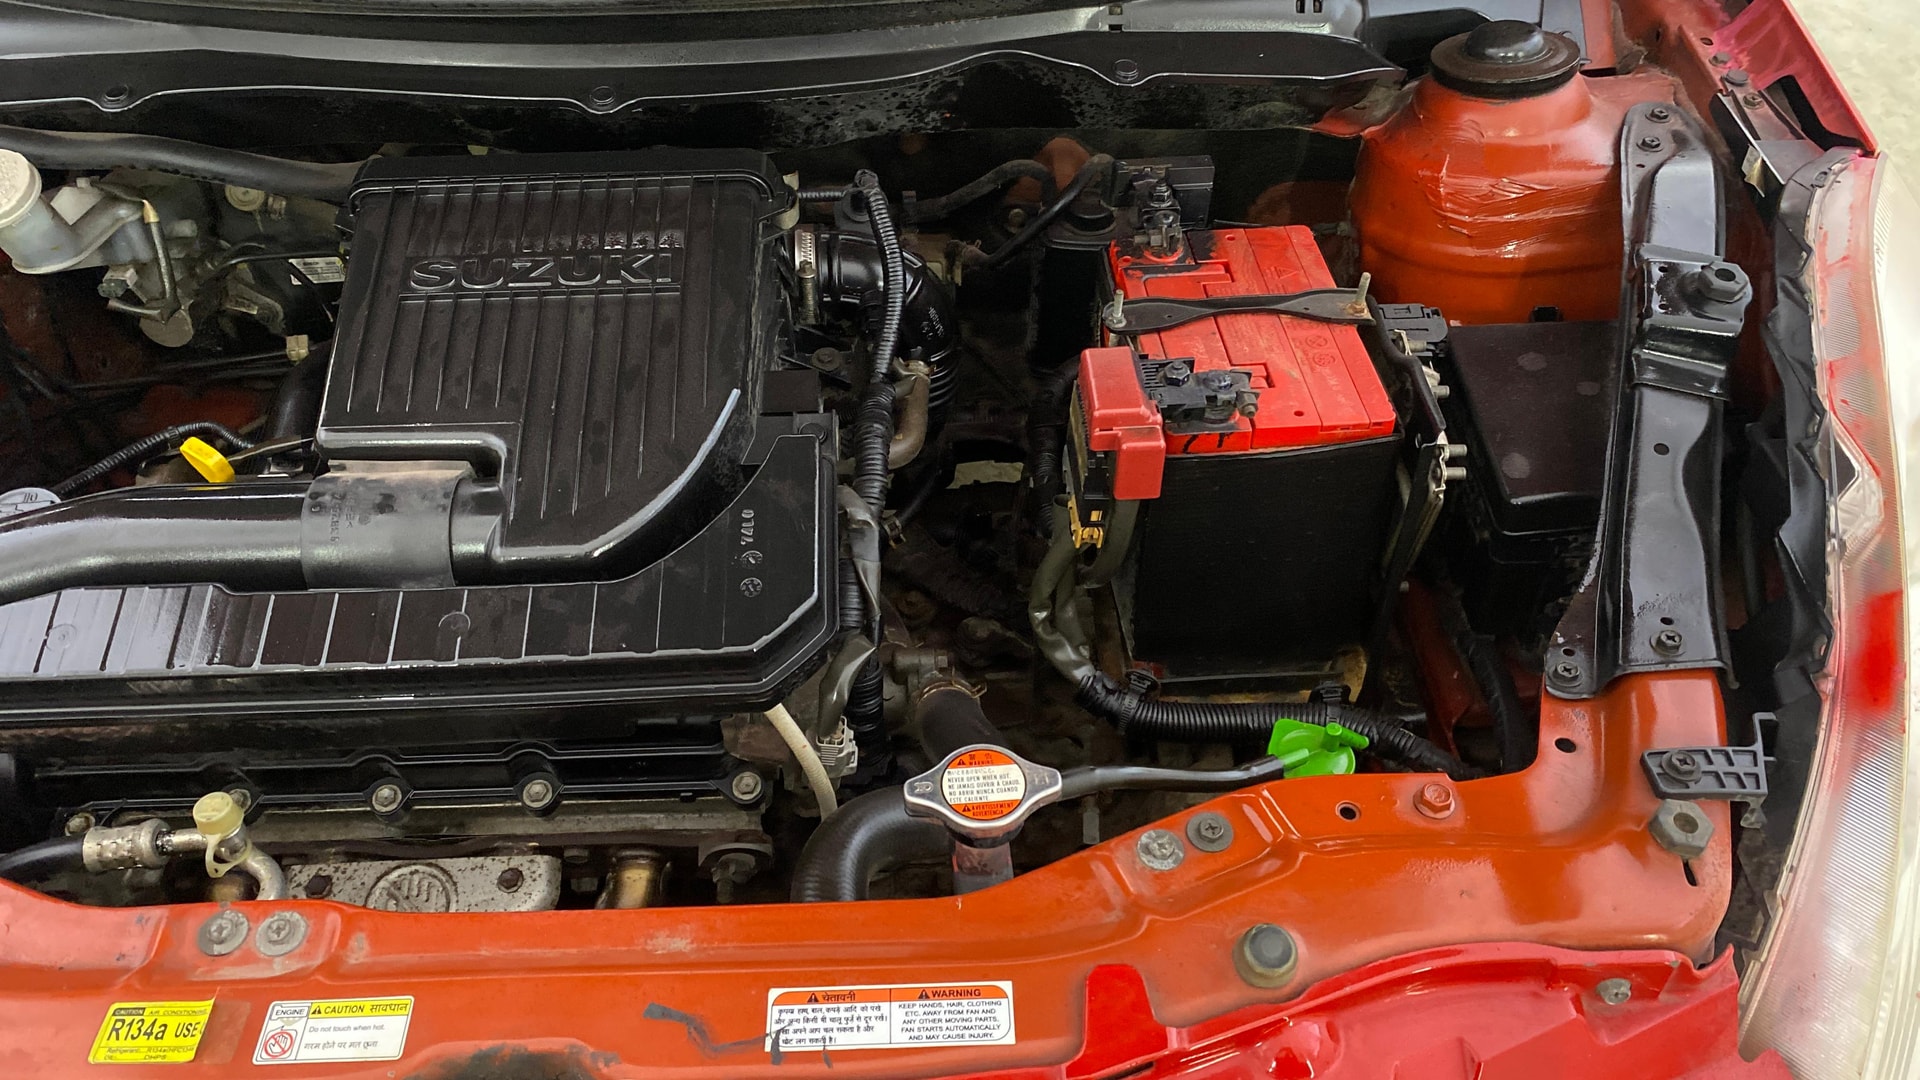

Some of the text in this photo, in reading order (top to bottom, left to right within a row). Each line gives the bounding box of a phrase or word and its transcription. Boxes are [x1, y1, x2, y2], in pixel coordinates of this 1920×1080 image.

[410, 254, 672, 290] SUZUKI
[822, 990, 856, 1002] चेतावनी
[931, 989, 981, 998] WARNING
[324, 1004, 364, 1014] CAUTION
[370, 1002, 408, 1013] सावधान
[106, 1018, 168, 1041] R134a
[174, 1022, 200, 1038] USE
[945, 1024, 1001, 1032] AUTOMATICALLY
